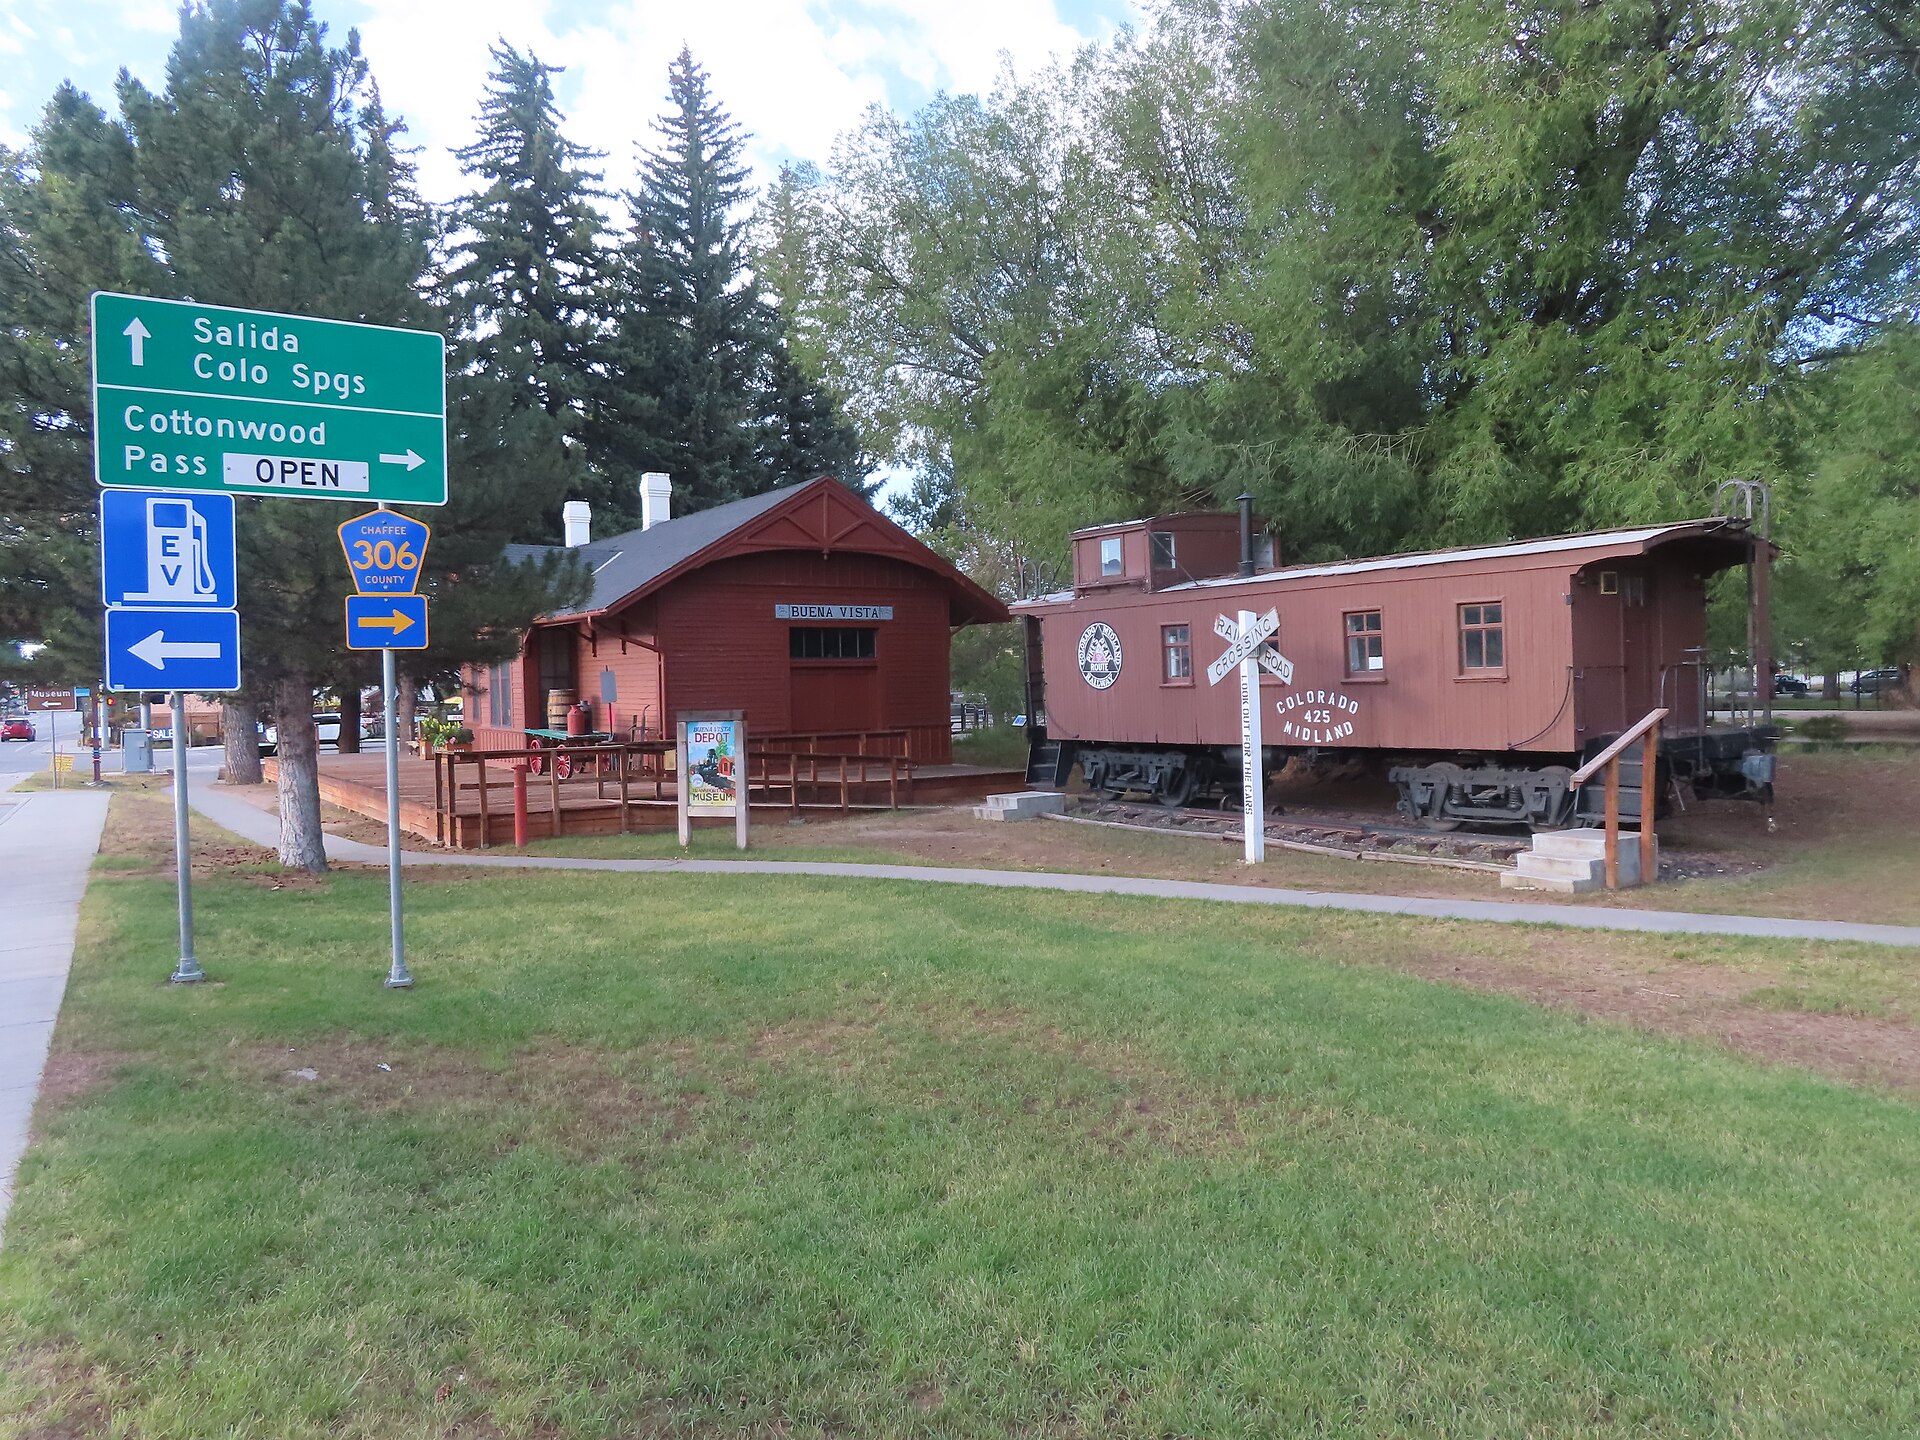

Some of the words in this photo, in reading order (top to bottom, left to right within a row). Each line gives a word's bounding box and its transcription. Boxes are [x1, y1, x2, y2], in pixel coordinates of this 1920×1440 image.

[193, 317, 299, 353] Salida
[193, 353, 269, 385] Colo
[292, 363, 366, 399] Spgs
[124, 405, 326, 445] Cottonwood
[124, 445, 207, 476] Pass
[255, 458, 340, 488] OPEN
[361, 526, 407, 535] CHAFFEE
[161, 535, 182, 586] EV
[352, 539, 418, 571] 306
[364, 575, 406, 584] COUNTY
[791, 606, 833, 617] BUENA
[839, 607, 879, 618] VISTA
[1079, 626, 1097, 665] COLORADO
[1103, 625, 1121, 664] MIDLAND
[1215, 618, 1272, 677] CROSSING
[1090, 663, 1108, 671] ROUTE
[1264, 650, 1290, 679] ROAD
[1085, 673, 1113, 687] RAILWAY
[1241, 675, 1249, 705] LOOK
[31, 690, 71, 698] Museum
[1276, 690, 1359, 715] COLORADO
[1304, 709, 1331, 724] 425
[152, 729, 174, 739] SALE
[695, 732, 730, 743] DEPOT
[1283, 720, 1354, 743] MIDLAND
[1244, 760, 1252, 782] THE
[693, 793, 733, 801] MUSEUM
